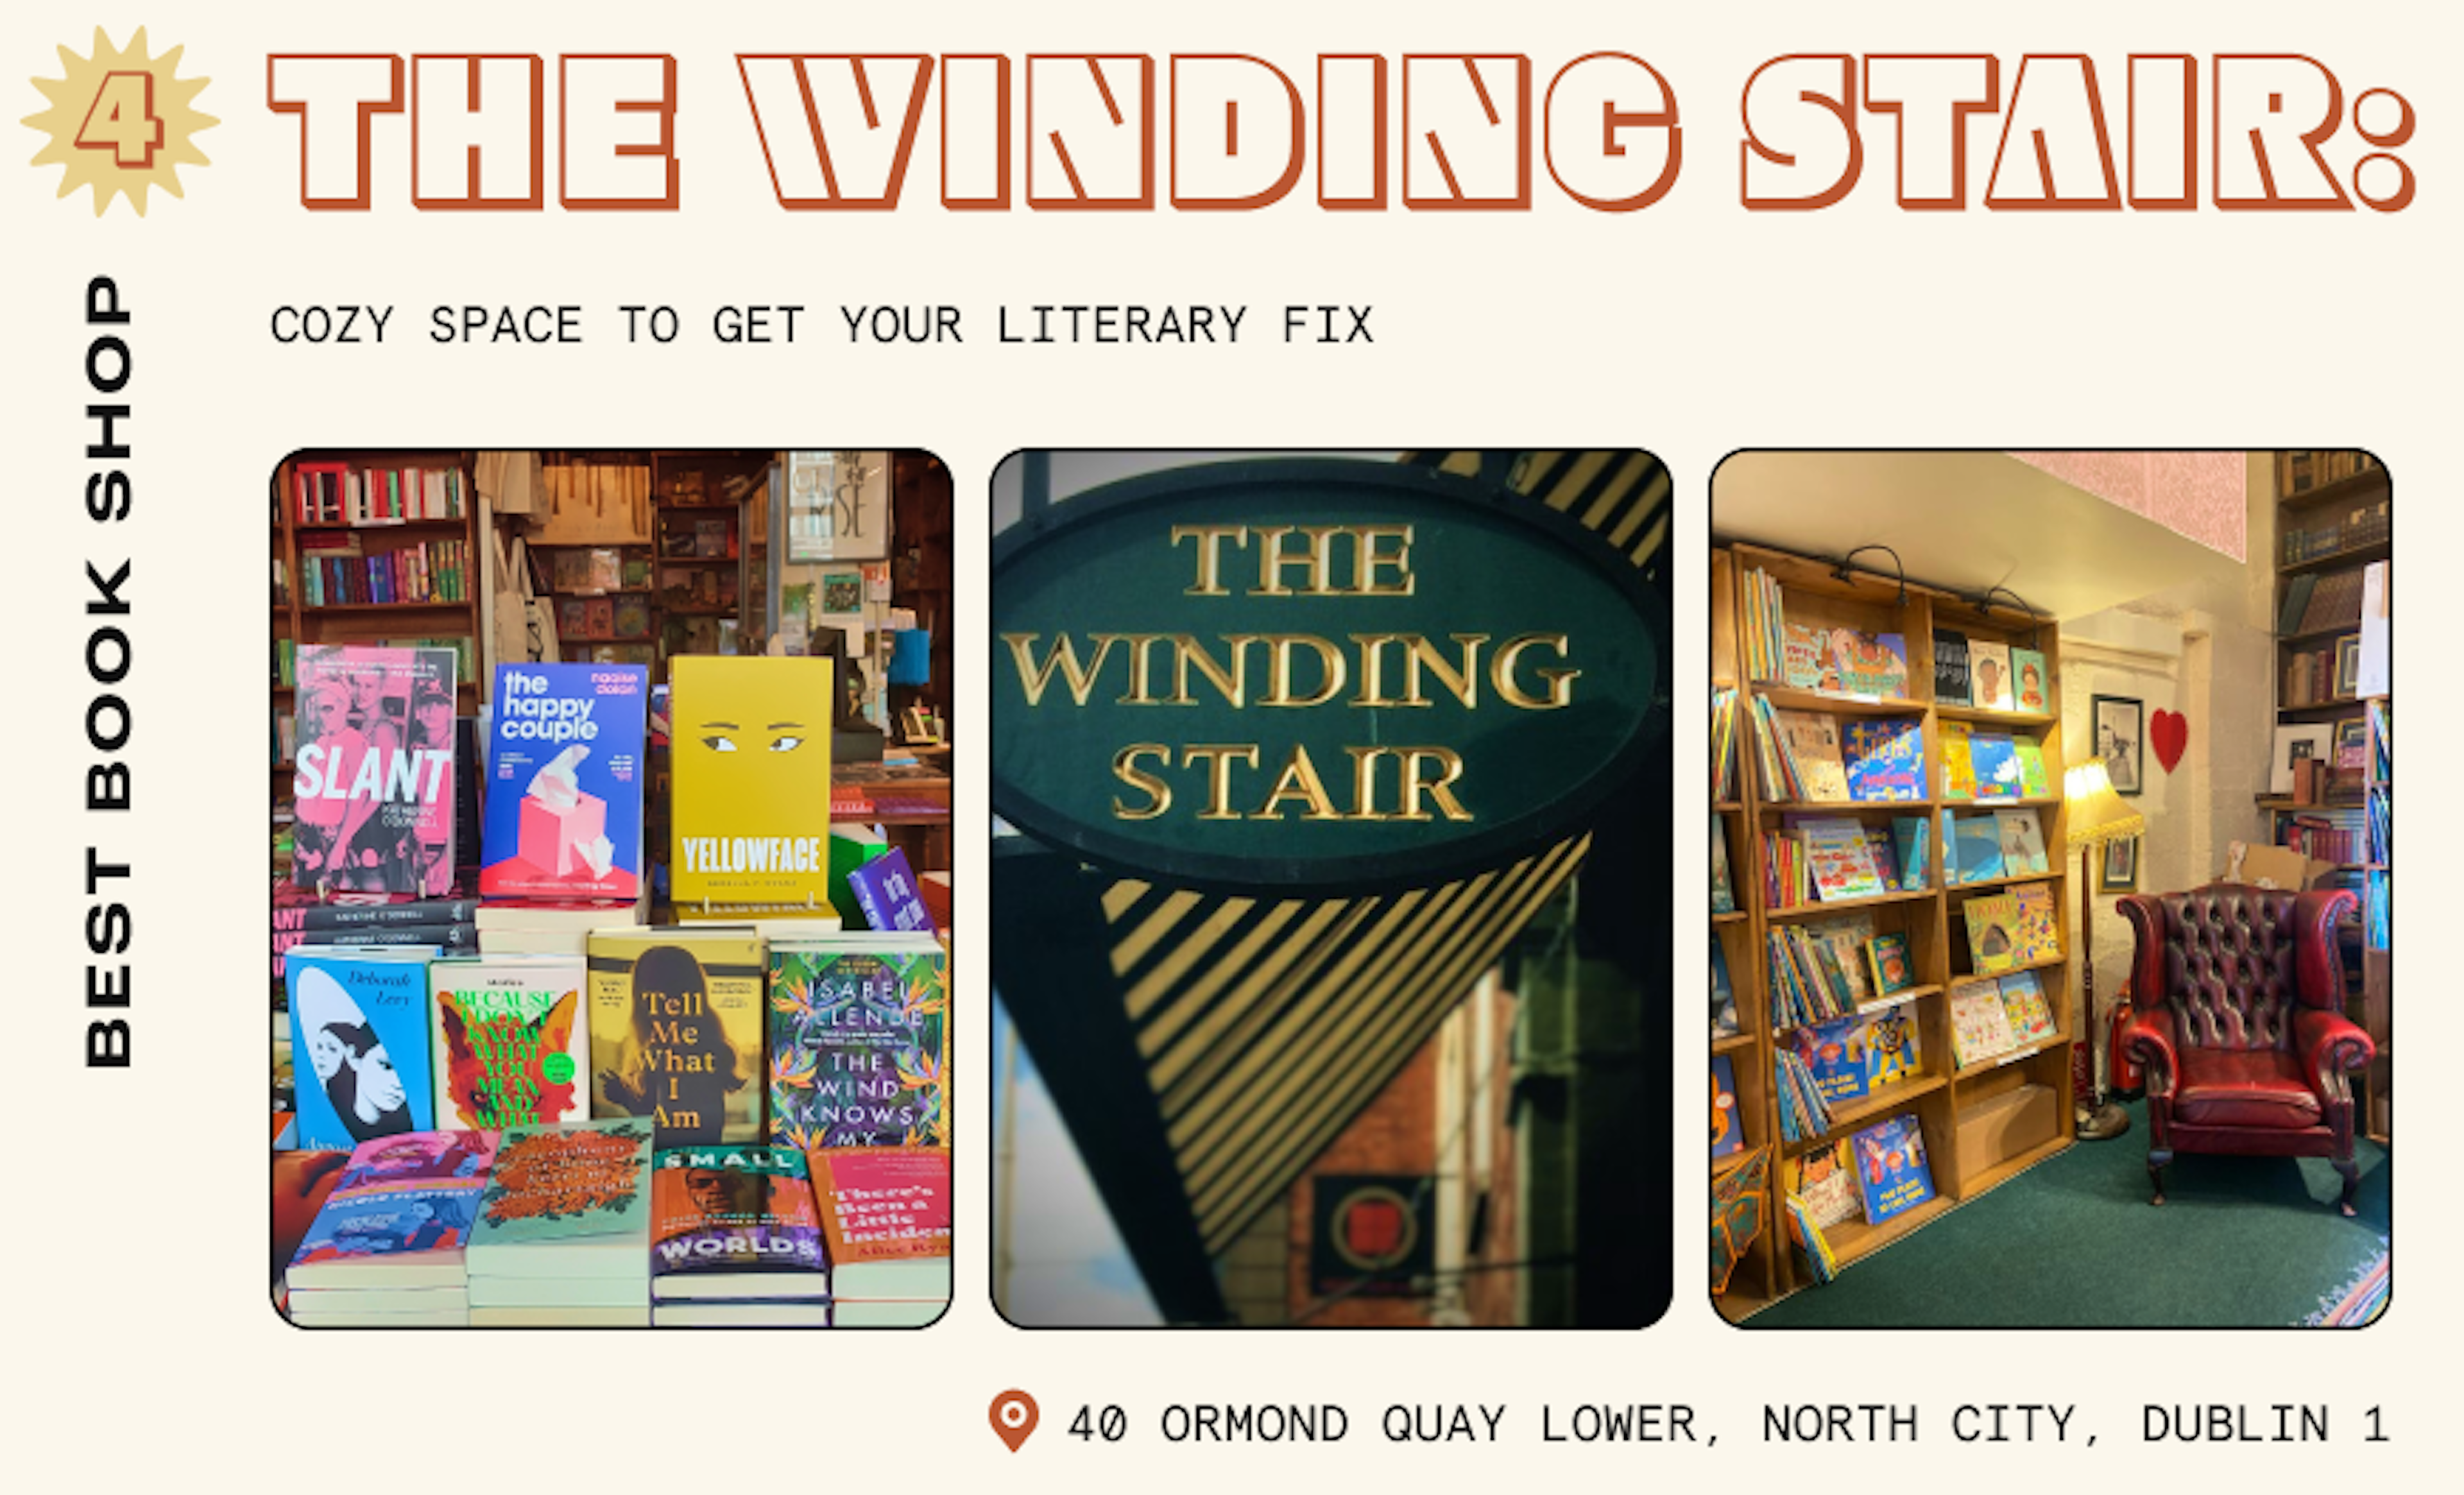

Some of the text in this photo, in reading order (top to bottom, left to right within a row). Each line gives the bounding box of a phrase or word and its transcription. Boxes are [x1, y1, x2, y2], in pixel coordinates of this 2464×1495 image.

[1170, 524, 1416, 597] THE
[1000, 632, 1583, 710] WINDING
[504, 670, 549, 695] the
[502, 694, 596, 722] happy
[501, 715, 599, 745] couple
[294, 743, 452, 803] SLANT
[1112, 742, 1475, 822] STAIR
[681, 836, 821, 874] YELLOWFACE
[348, 970, 411, 987] Deborah
[454, 990, 556, 1008] BECAUSE
[809, 980, 906, 1001] ISABEL
[641, 991, 705, 1017] Tell
[790, 1007, 925, 1027] ALLENDE
[468, 1025, 542, 1045] KNOW
[650, 1020, 700, 1046] Me
[473, 1042, 538, 1061] WHAT
[634, 1048, 717, 1073] What
[483, 1061, 527, 1079] YOU
[832, 1052, 883, 1072] THE
[476, 1077, 542, 1097] MEAN
[668, 1077, 680, 1100] I
[816, 1080, 900, 1098] WIND
[489, 1095, 536, 1113] AND
[475, 1111, 543, 1131] WHAT
[653, 1105, 702, 1129] Am
[800, 1105, 915, 1125] KNOWS
[837, 1131, 877, 1147] MY
[663, 1150, 795, 1169] SMALL
[828, 1184, 935, 1203] There's
[835, 1200, 908, 1217] Been
[837, 1211, 916, 1230] Little
[660, 1235, 818, 1261] WORLDS
